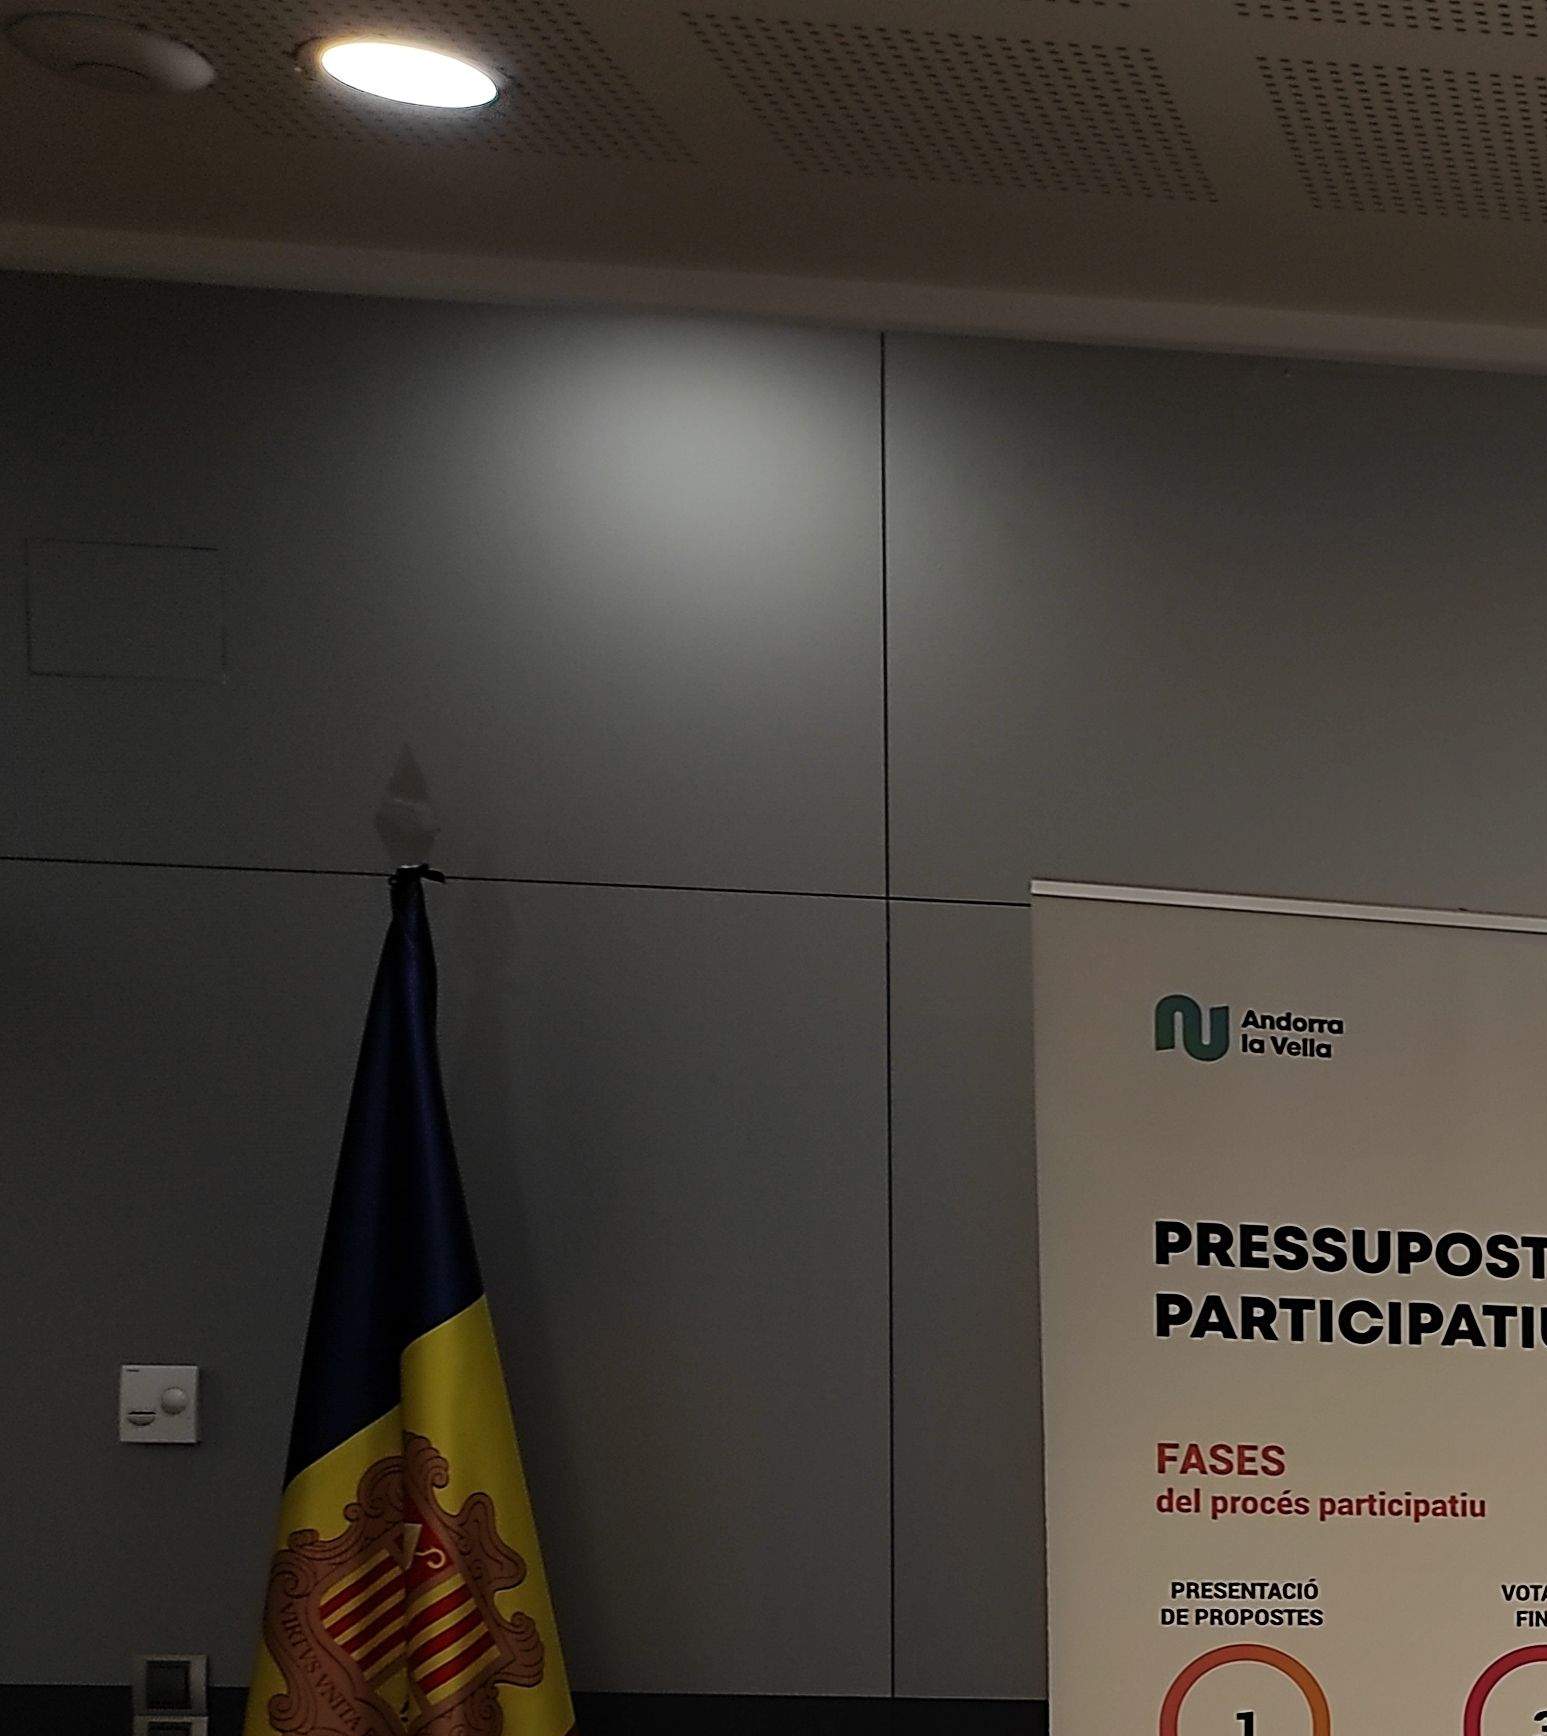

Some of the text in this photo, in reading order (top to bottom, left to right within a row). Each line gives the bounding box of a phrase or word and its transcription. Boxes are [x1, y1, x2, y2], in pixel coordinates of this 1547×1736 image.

[1240, 1009, 1345, 1036] Andorra
[1240, 1034, 1333, 1059] la Vella
[1156, 1444, 1286, 1478] FASES
[1156, 1488, 1486, 1522] del procés participatiu
[1171, 1579, 1320, 1602] PRESENTACIÓ
[1160, 1606, 1324, 1628] DE PROPOSTES
